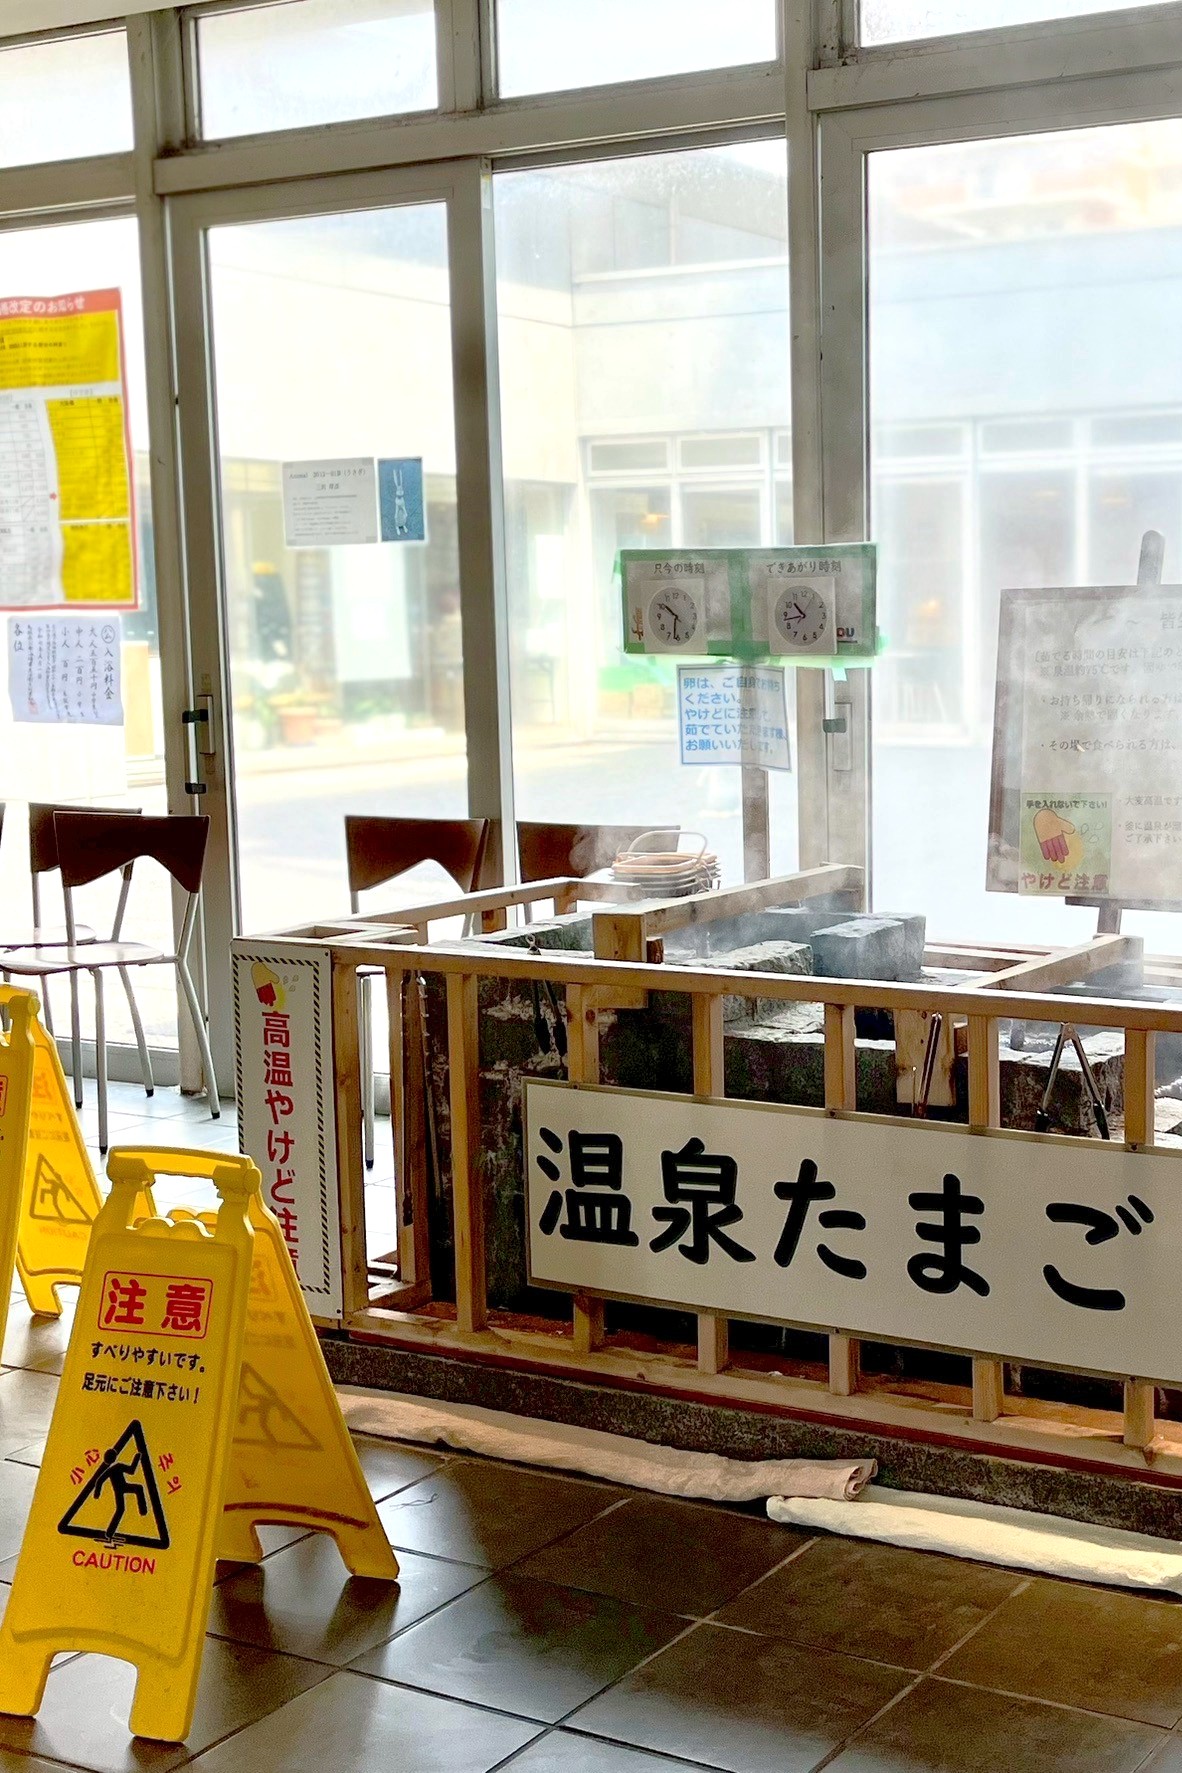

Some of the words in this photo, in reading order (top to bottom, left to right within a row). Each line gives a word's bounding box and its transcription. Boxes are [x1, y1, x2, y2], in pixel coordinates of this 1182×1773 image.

[653, 563, 705, 574] 只今の時刻
[766, 560, 842, 573] できあがり時刻
[14, 624, 23, 651] 各位
[684, 692, 742, 705] ください。
[1021, 872, 1109, 891] やけど注意
[535, 1124, 1155, 1312] 温泉たまご
[104, 1277, 206, 1332] 注意
[90, 1340, 206, 1373] すべりやすいです。
[81, 1371, 201, 1405] 足元にご注意下さい!
[72, 1549, 157, 1575] CAUTION
